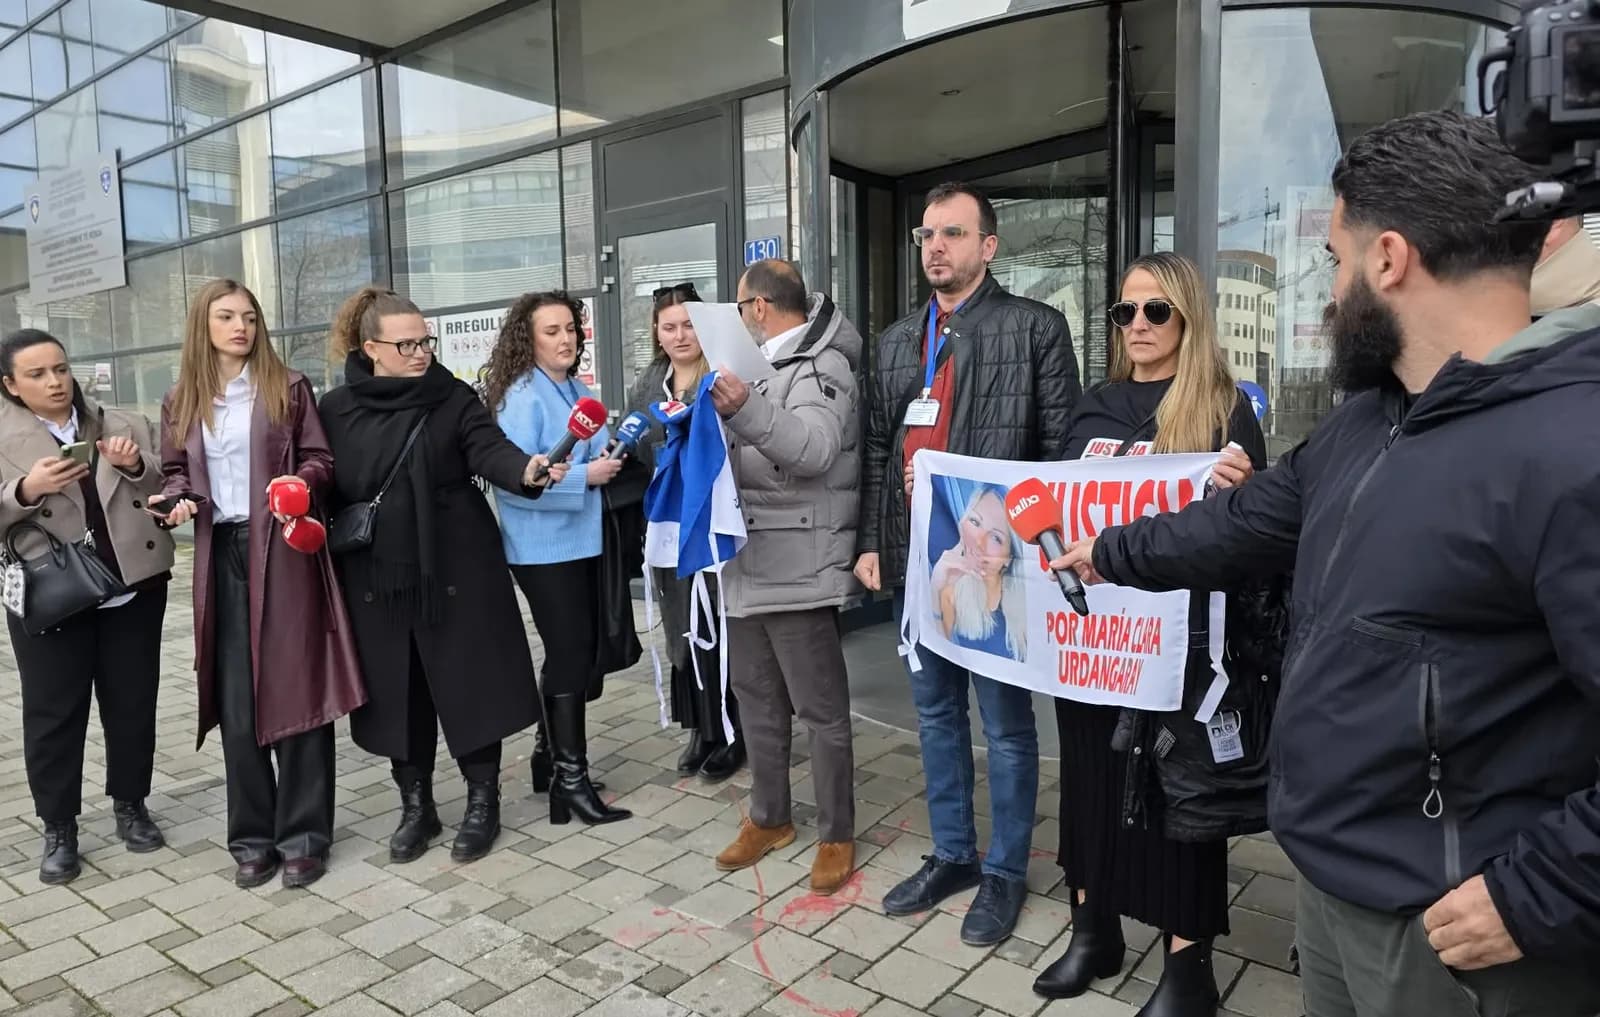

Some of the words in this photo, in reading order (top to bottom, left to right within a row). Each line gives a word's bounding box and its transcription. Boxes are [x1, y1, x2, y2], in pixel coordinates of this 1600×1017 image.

[748, 239, 776, 263] 130
[575, 411, 600, 430] KTV
[1046, 611, 1079, 646] POR
[1081, 607, 1132, 653] MARÍA
[1130, 617, 1161, 656] CLARA
